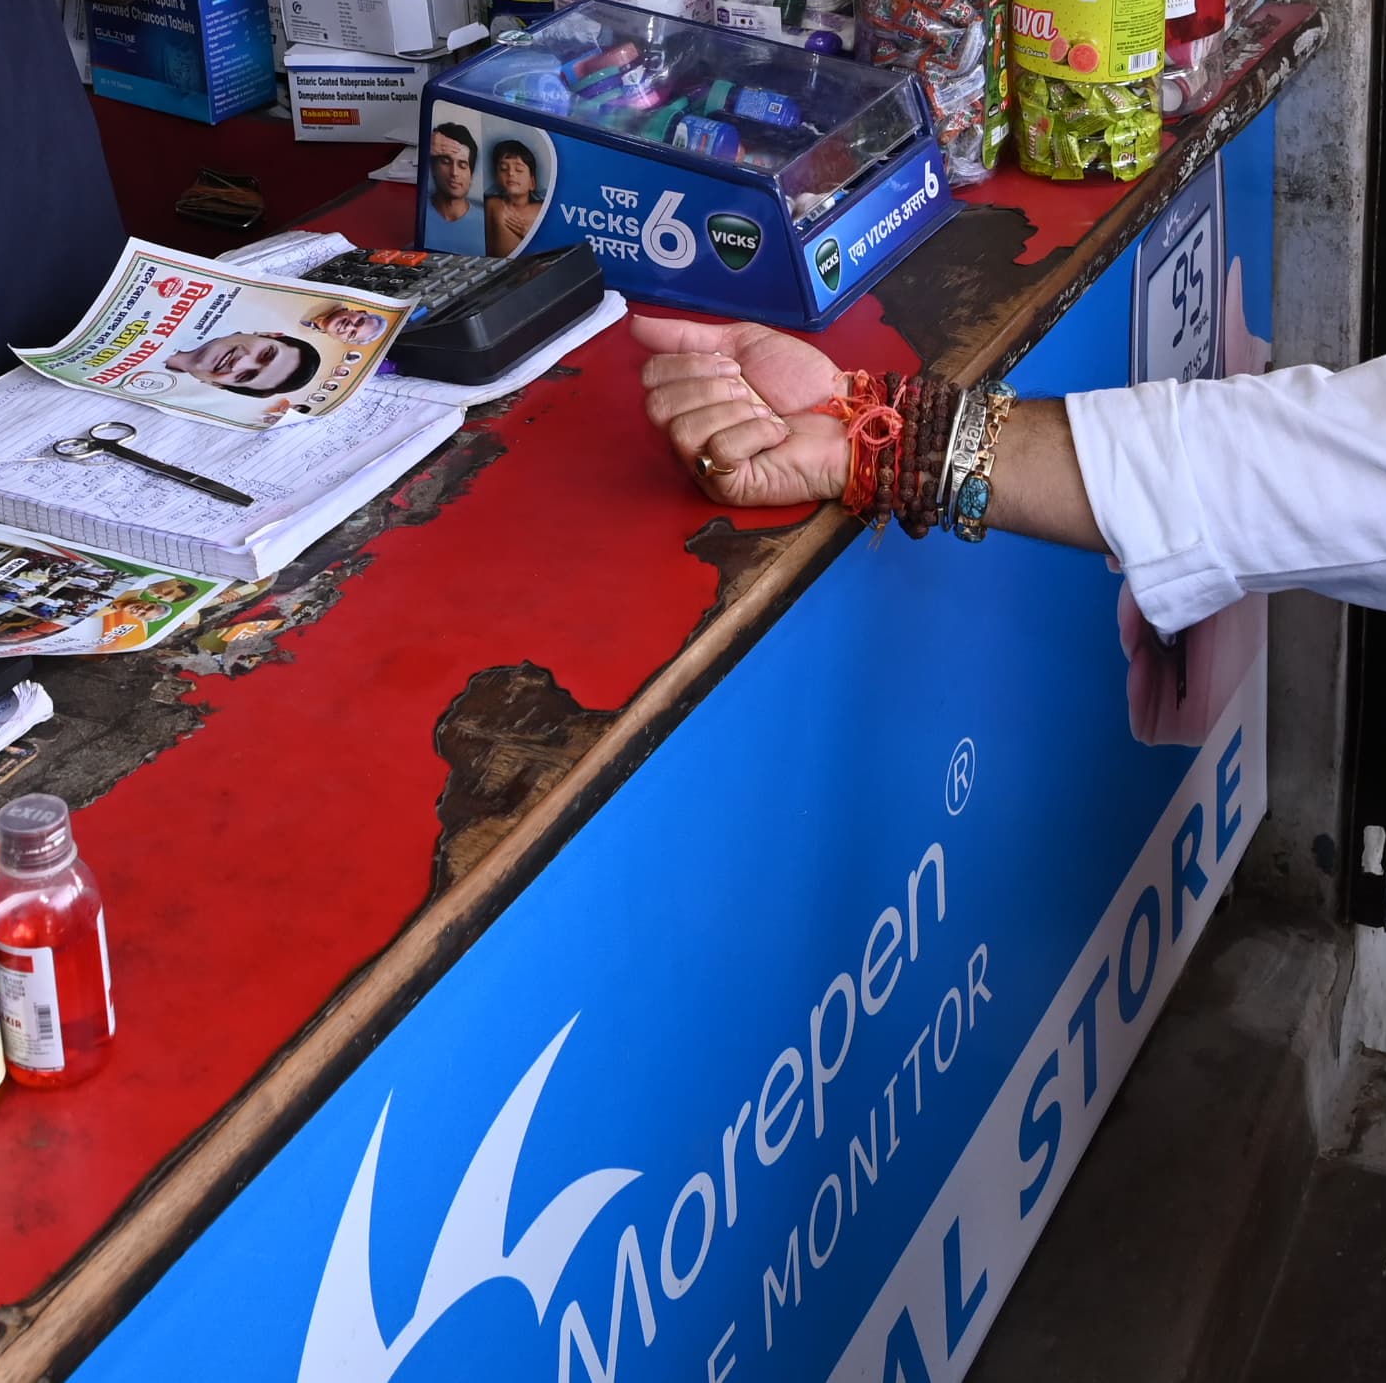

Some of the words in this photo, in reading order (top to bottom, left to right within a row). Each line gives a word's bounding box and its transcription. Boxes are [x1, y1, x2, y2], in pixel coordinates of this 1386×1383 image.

[131, 7, 168, 27] Charcoal
[170, 17, 196, 35] Tablets
[296, 76, 316, 87] Enteric
[317, 77, 339, 87] Coated
[339, 77, 375, 88] Rabeprazole
[376, 77, 398, 87] Sodium
[298, 90, 335, 102] Domperidone
[336, 91, 365, 101] Sustained
[366, 92, 390, 101] Release
[391, 92, 418, 102] Capsules
[600, 185, 639, 210] एक
[847, 242, 867, 265] एक
[864, 207, 903, 248] VICKS
[900, 187, 928, 223] असर
[924, 160, 940, 200] 6
[560, 202, 640, 238] VICKS
[641, 190, 697, 270] 6
[584, 233, 640, 263] असर
[711, 229, 758, 250] VICKS
[818, 250, 840, 276] VICKS
[1172, 230, 1204, 348] 95
[153, 278, 214, 341] विकास
[111, 317, 152, 354] पंजा
[84, 346, 120, 373] छाप
[88, 338, 164, 391] उपाध्याय
[1017, 723, 1244, 1222] STORE
[557, 842, 947, 1383] Morepen
[763, 943, 993, 1352] MONITOR
